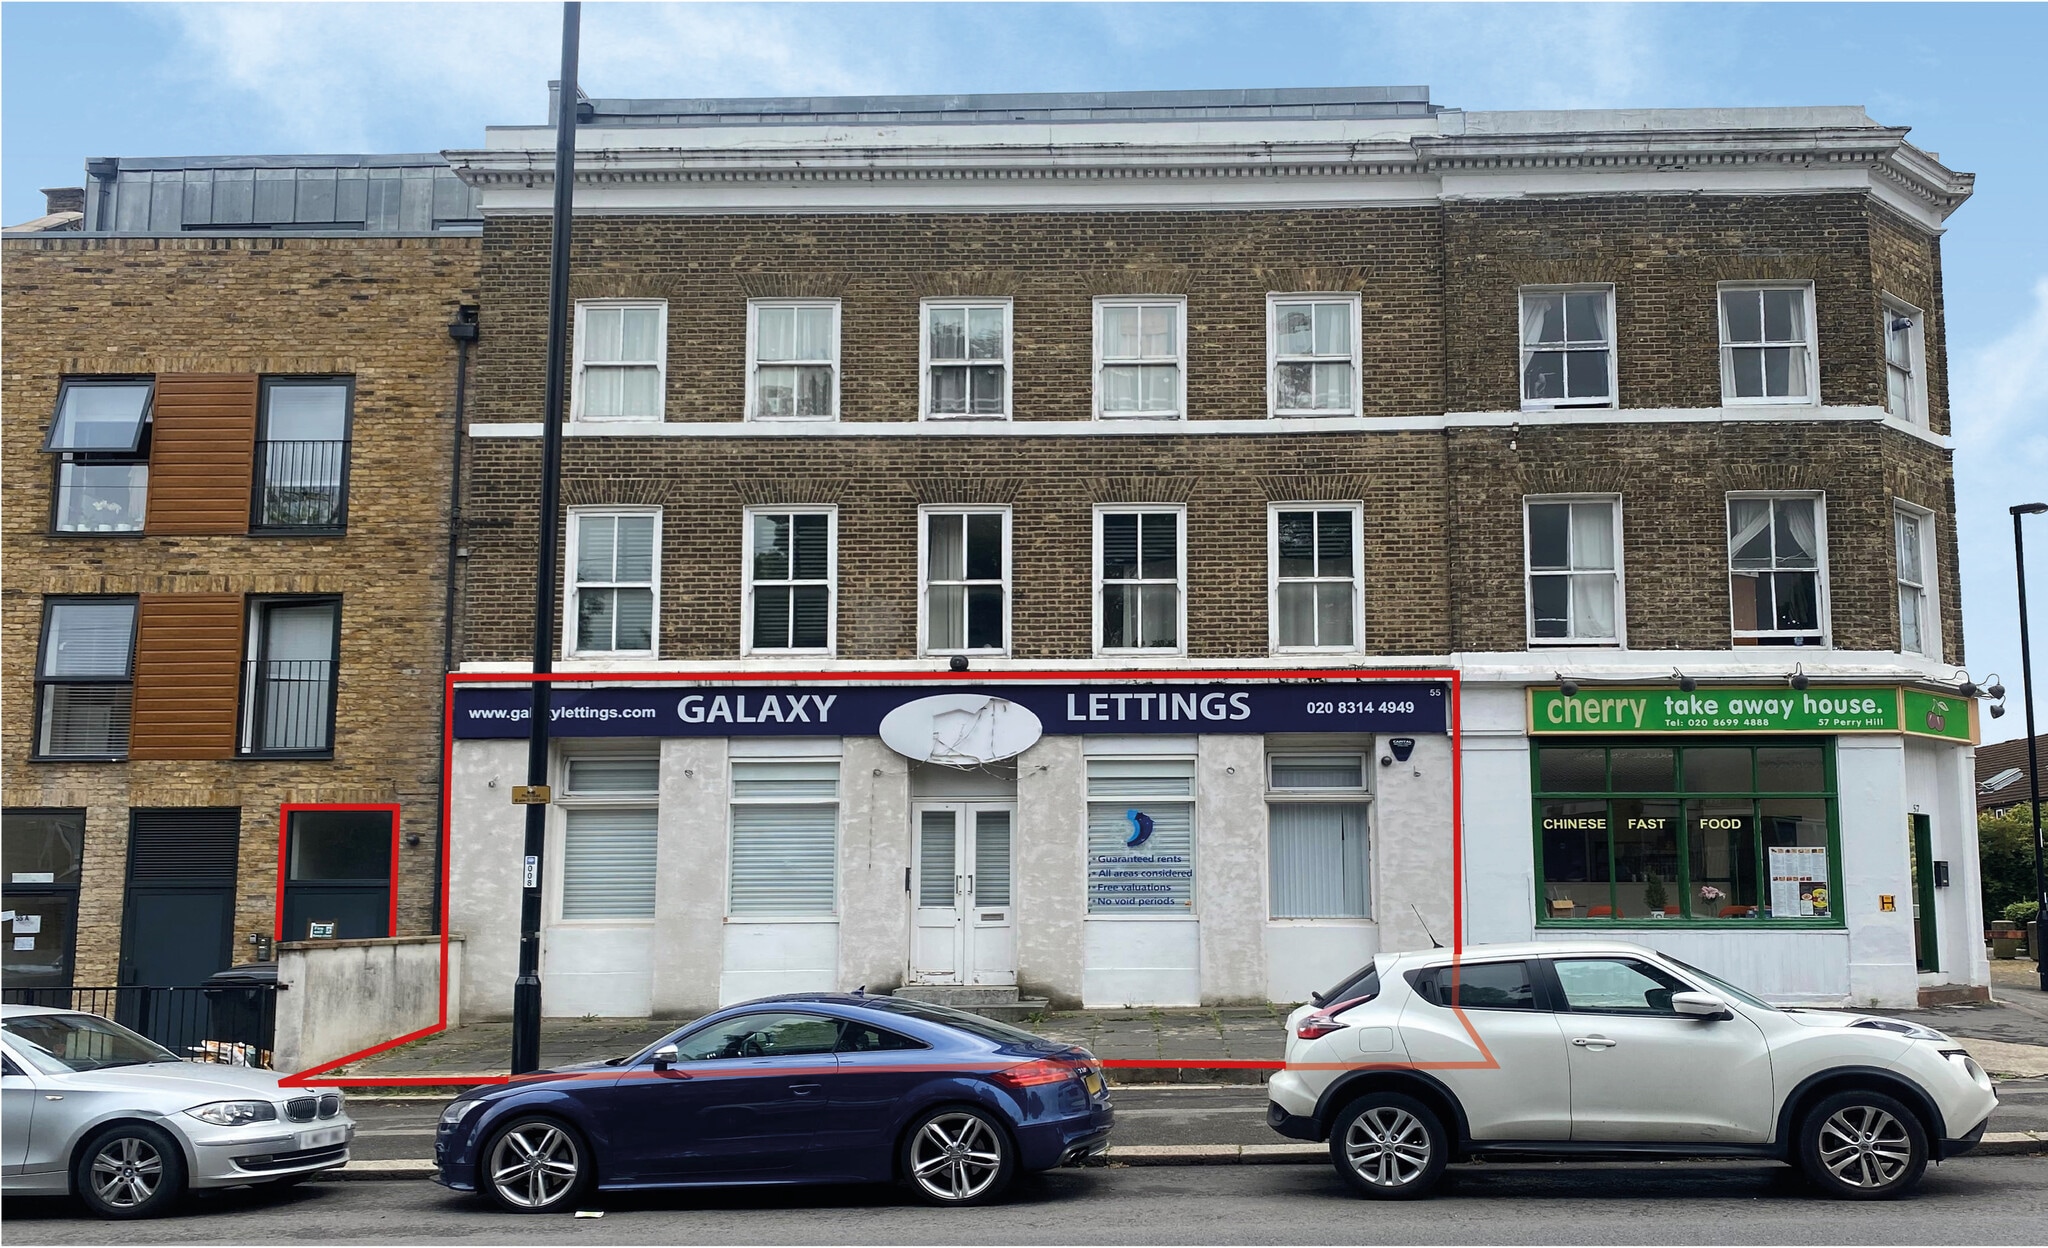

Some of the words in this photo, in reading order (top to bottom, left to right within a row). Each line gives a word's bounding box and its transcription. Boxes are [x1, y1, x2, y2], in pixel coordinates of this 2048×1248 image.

[1429, 689, 1441, 697] 55
[677, 694, 837, 723] GALAXY
[1067, 692, 1251, 721] LETTINGS
[1306, 701, 1334, 714] 020
[1338, 701, 1375, 714] 8314
[1378, 701, 1415, 714] 4949
[1547, 695, 1647, 728] cherry
[1664, 694, 1719, 716] take
[1728, 699, 1794, 720] away
[1803, 693, 1883, 714] house.
[468, 706, 656, 721] www.galylettings.com
[1665, 719, 1684, 727] Tel:
[1688, 719, 1709, 727] 020
[1818, 718, 1830, 726] 57
[1833, 718, 1862, 727] Perry
[1866, 718, 1884, 726] Hill
[1543, 818, 1607, 830] CHINESE
[1628, 818, 1666, 830] FAST
[1700, 818, 1742, 830] FOOD
[1098, 855, 1154, 863] Guaranteed
[1098, 869, 1111, 877] All
[1140, 869, 1193, 877] considered
[1121, 883, 1172, 892] valuations
[1115, 897, 1136, 905] void
[1138, 897, 1175, 906] periods
